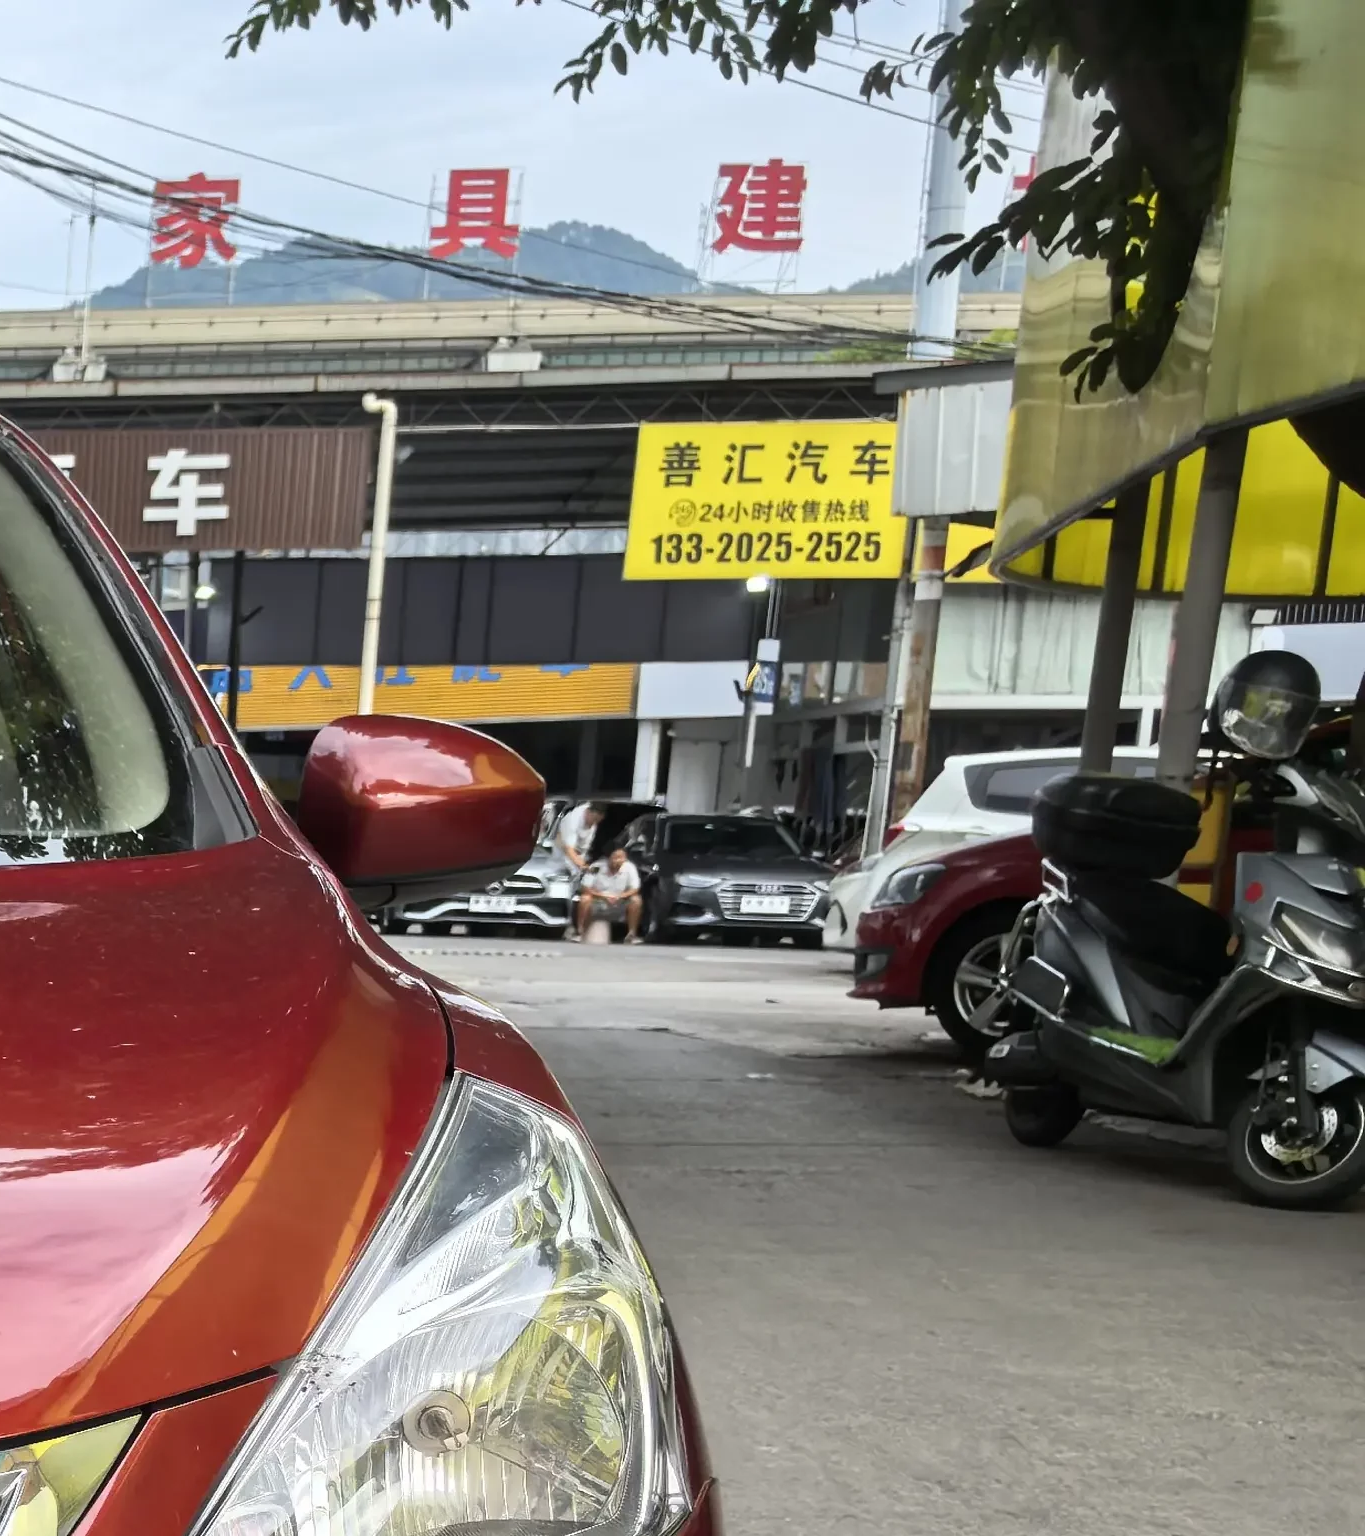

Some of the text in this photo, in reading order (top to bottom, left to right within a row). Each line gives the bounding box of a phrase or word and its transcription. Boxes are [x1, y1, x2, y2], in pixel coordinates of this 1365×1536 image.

[658, 439, 892, 488] 善汇汽车
[698, 498, 870, 524] 24小时收售热线
[650, 530, 883, 565] 133-2025-2525
